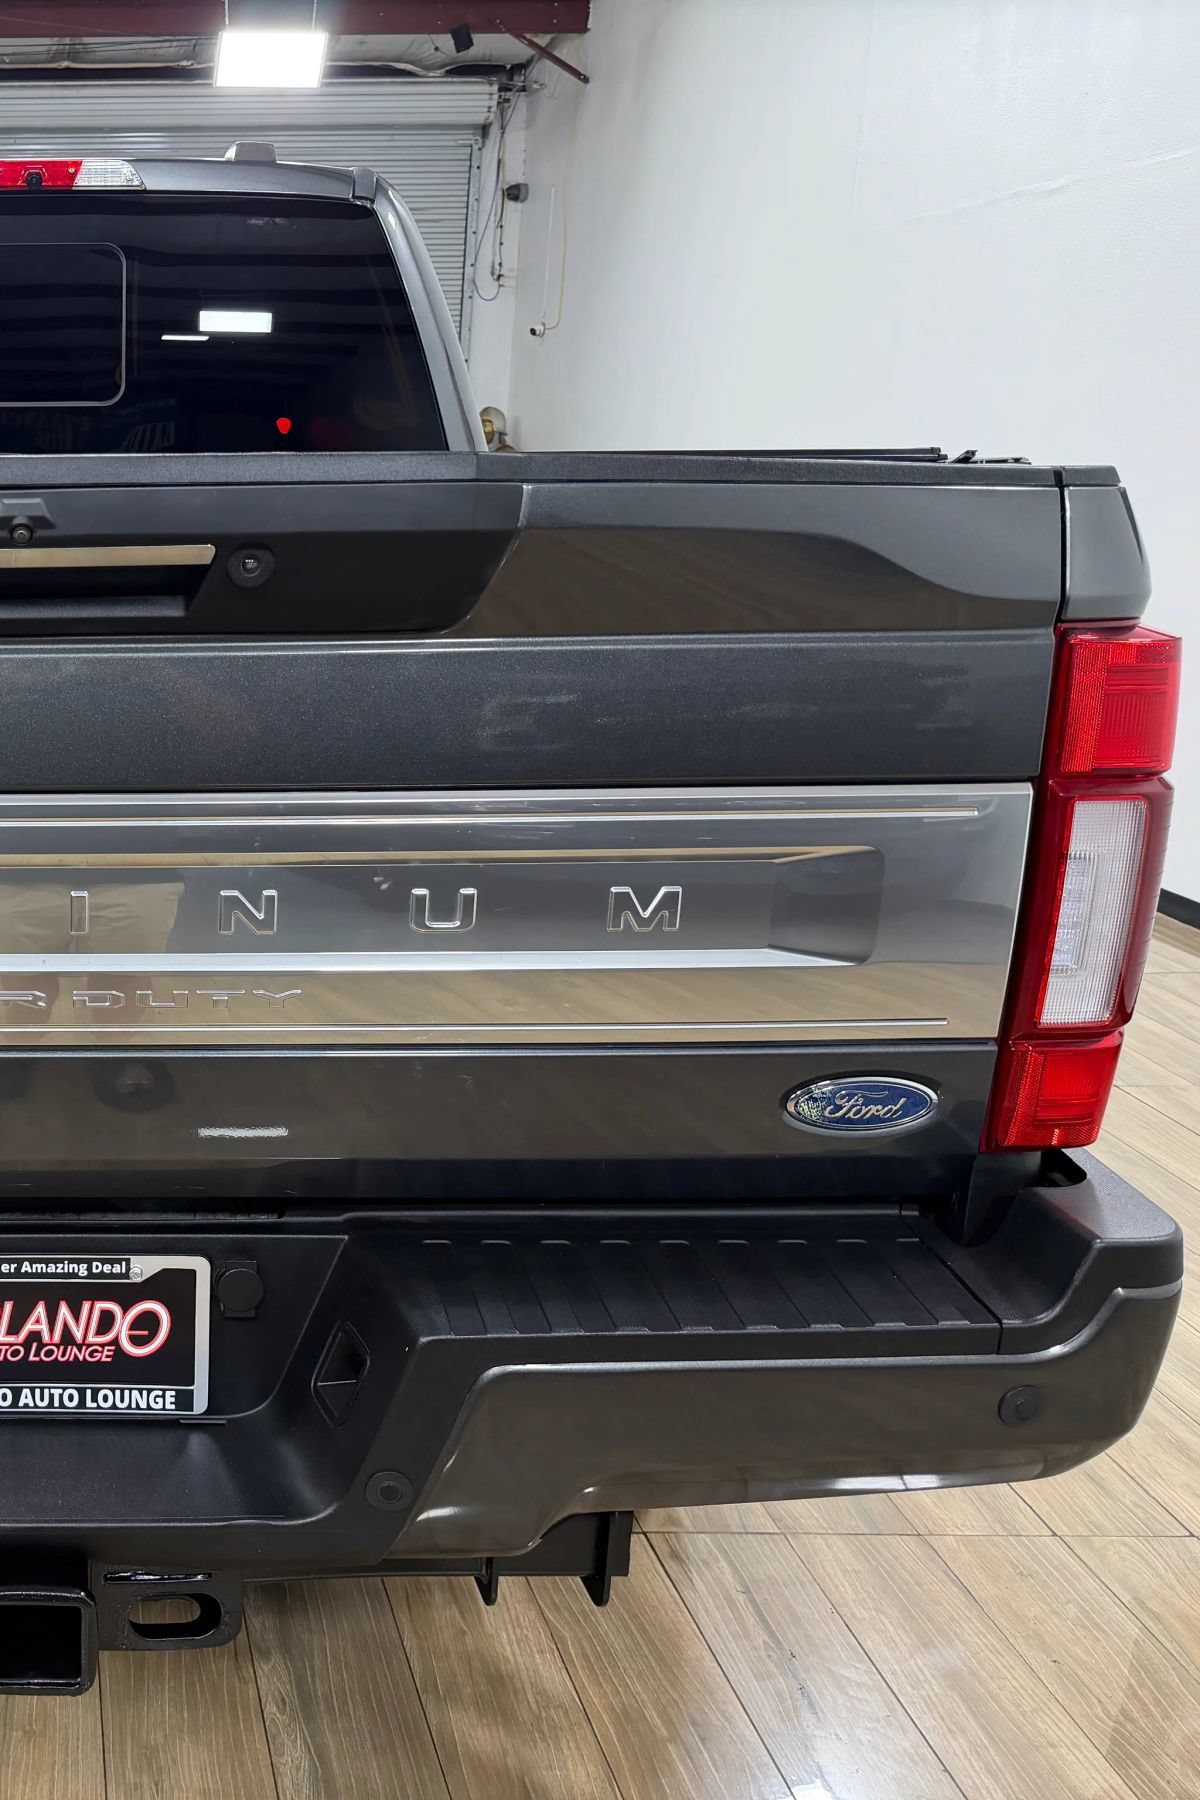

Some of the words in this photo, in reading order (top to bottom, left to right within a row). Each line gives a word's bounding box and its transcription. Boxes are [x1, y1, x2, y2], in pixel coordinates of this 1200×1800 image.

[72, 989, 302, 1009] DUTY
[824, 1090, 907, 1119] Ford
[20, 1260, 89, 1278] Amazing
[92, 1261, 127, 1274] Deal
[28, 1344, 116, 1363] LOUNGE
[18, 1388, 80, 1409] AUTO
[85, 1388, 177, 1410] LOUNGE
